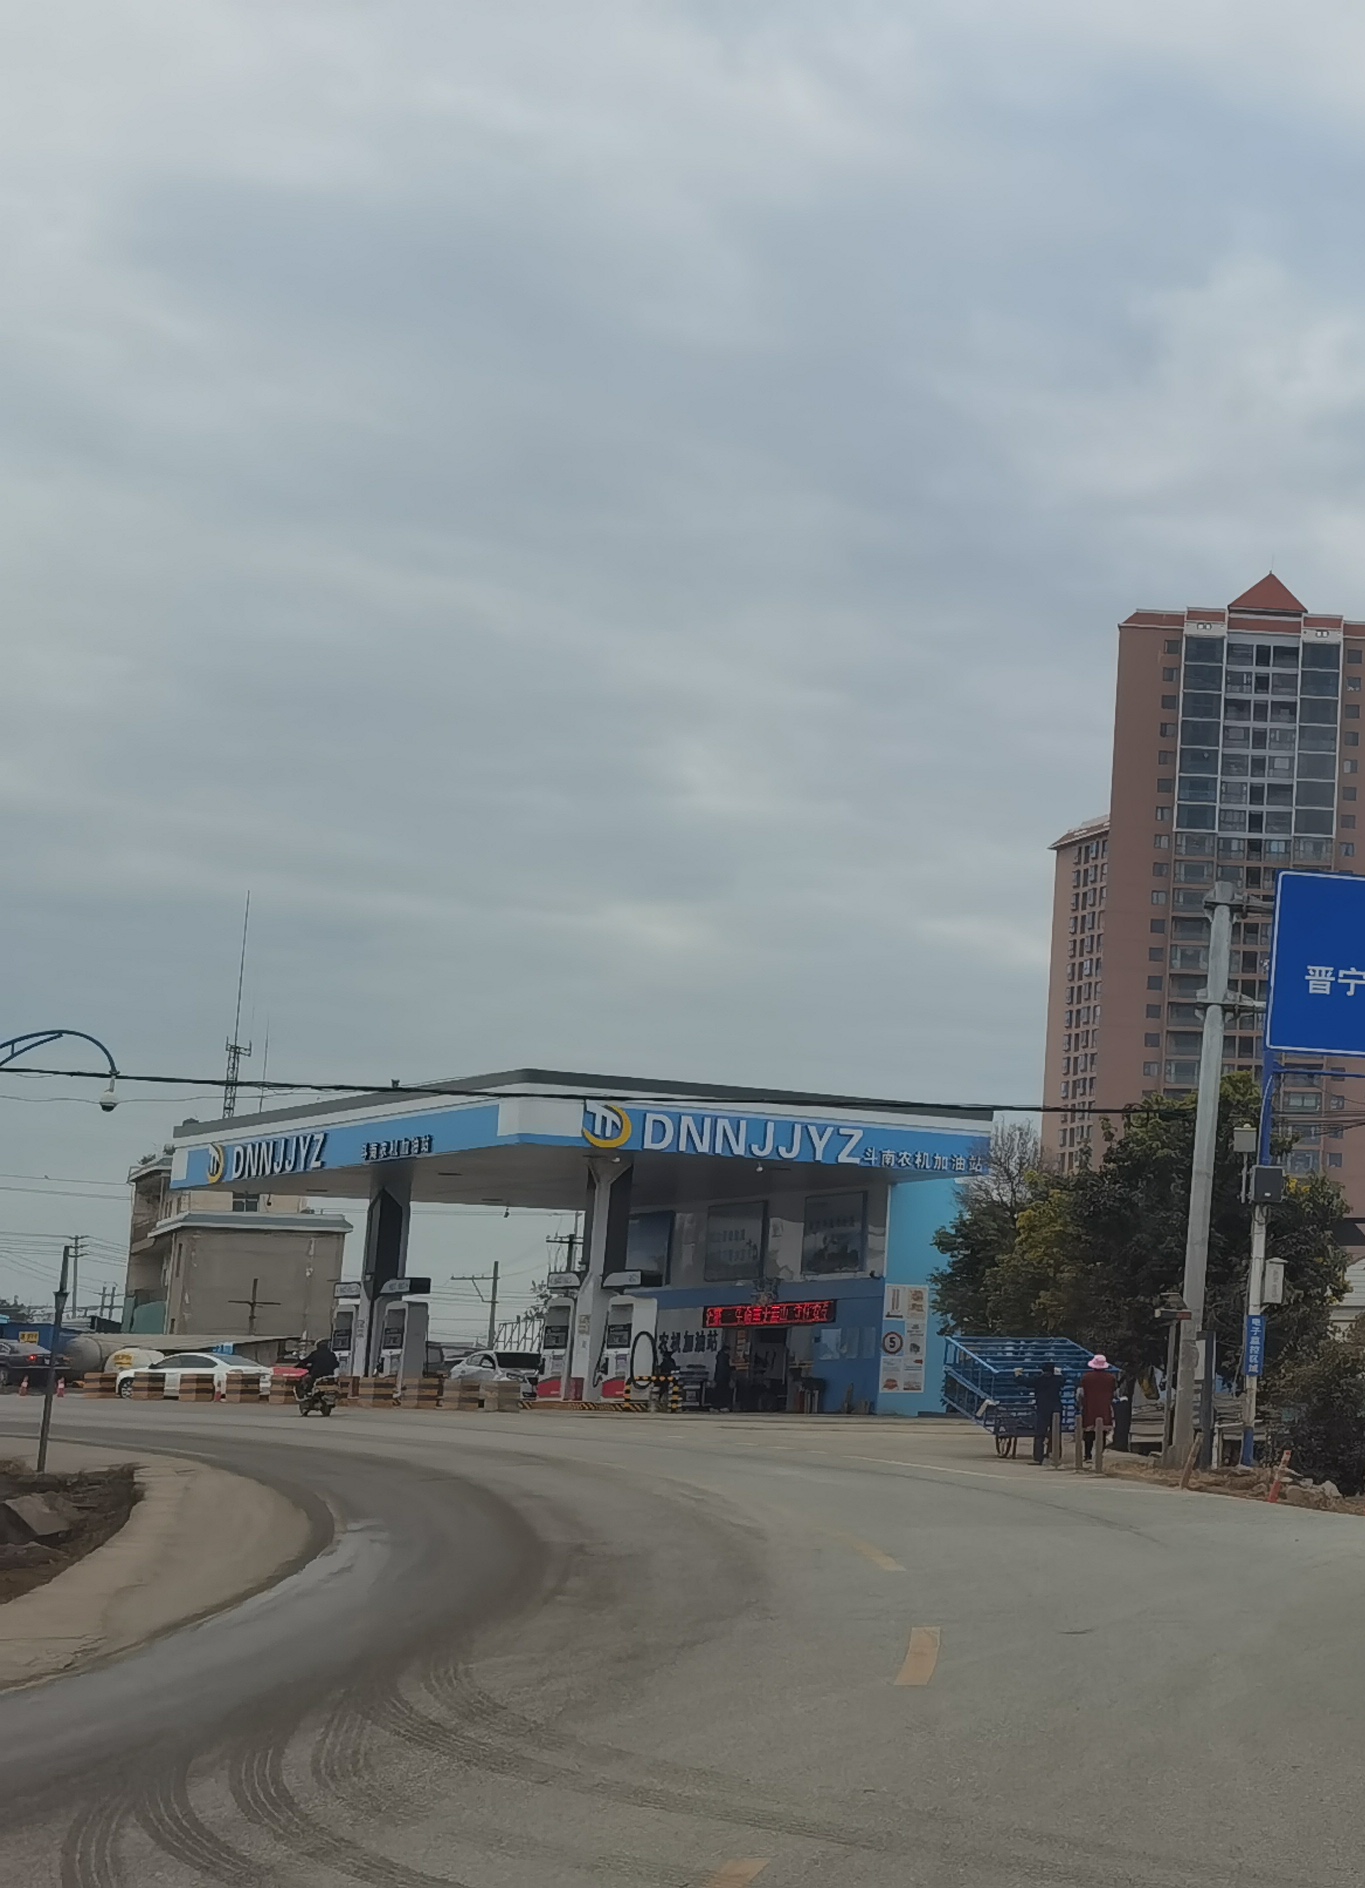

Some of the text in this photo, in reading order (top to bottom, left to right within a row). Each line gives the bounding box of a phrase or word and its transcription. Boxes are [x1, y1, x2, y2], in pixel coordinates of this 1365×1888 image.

[231, 1133, 326, 1179] DNNJJYZ
[642, 1113, 864, 1164] DNNJJYZ
[863, 1147, 983, 1173] 斗南农机加油站
